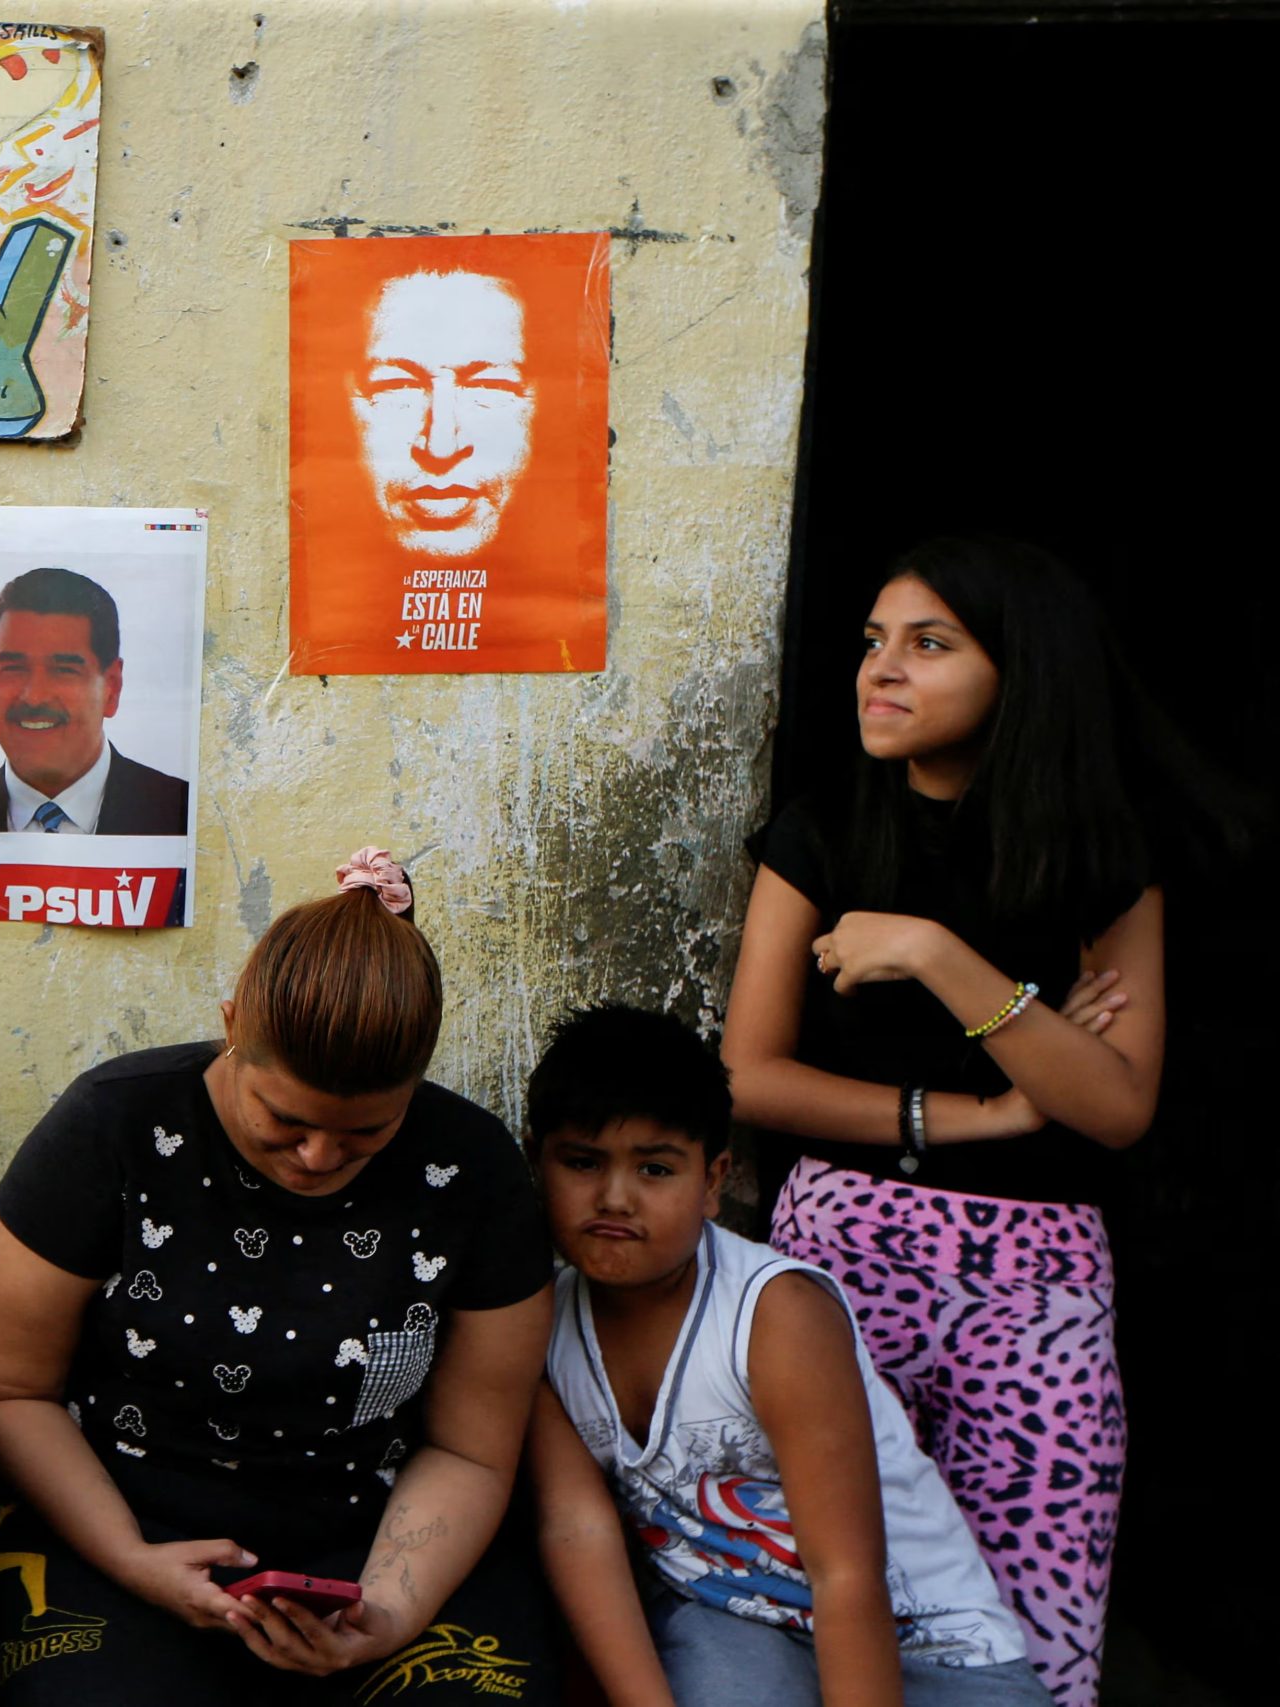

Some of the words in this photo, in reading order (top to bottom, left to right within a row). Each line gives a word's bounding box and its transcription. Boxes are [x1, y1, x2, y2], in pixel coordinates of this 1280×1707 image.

[412, 569, 487, 588] ESPERANZA
[401, 588, 450, 620] ESTÁ
[457, 592, 483, 619] EN
[421, 622, 481, 650] CALLE
